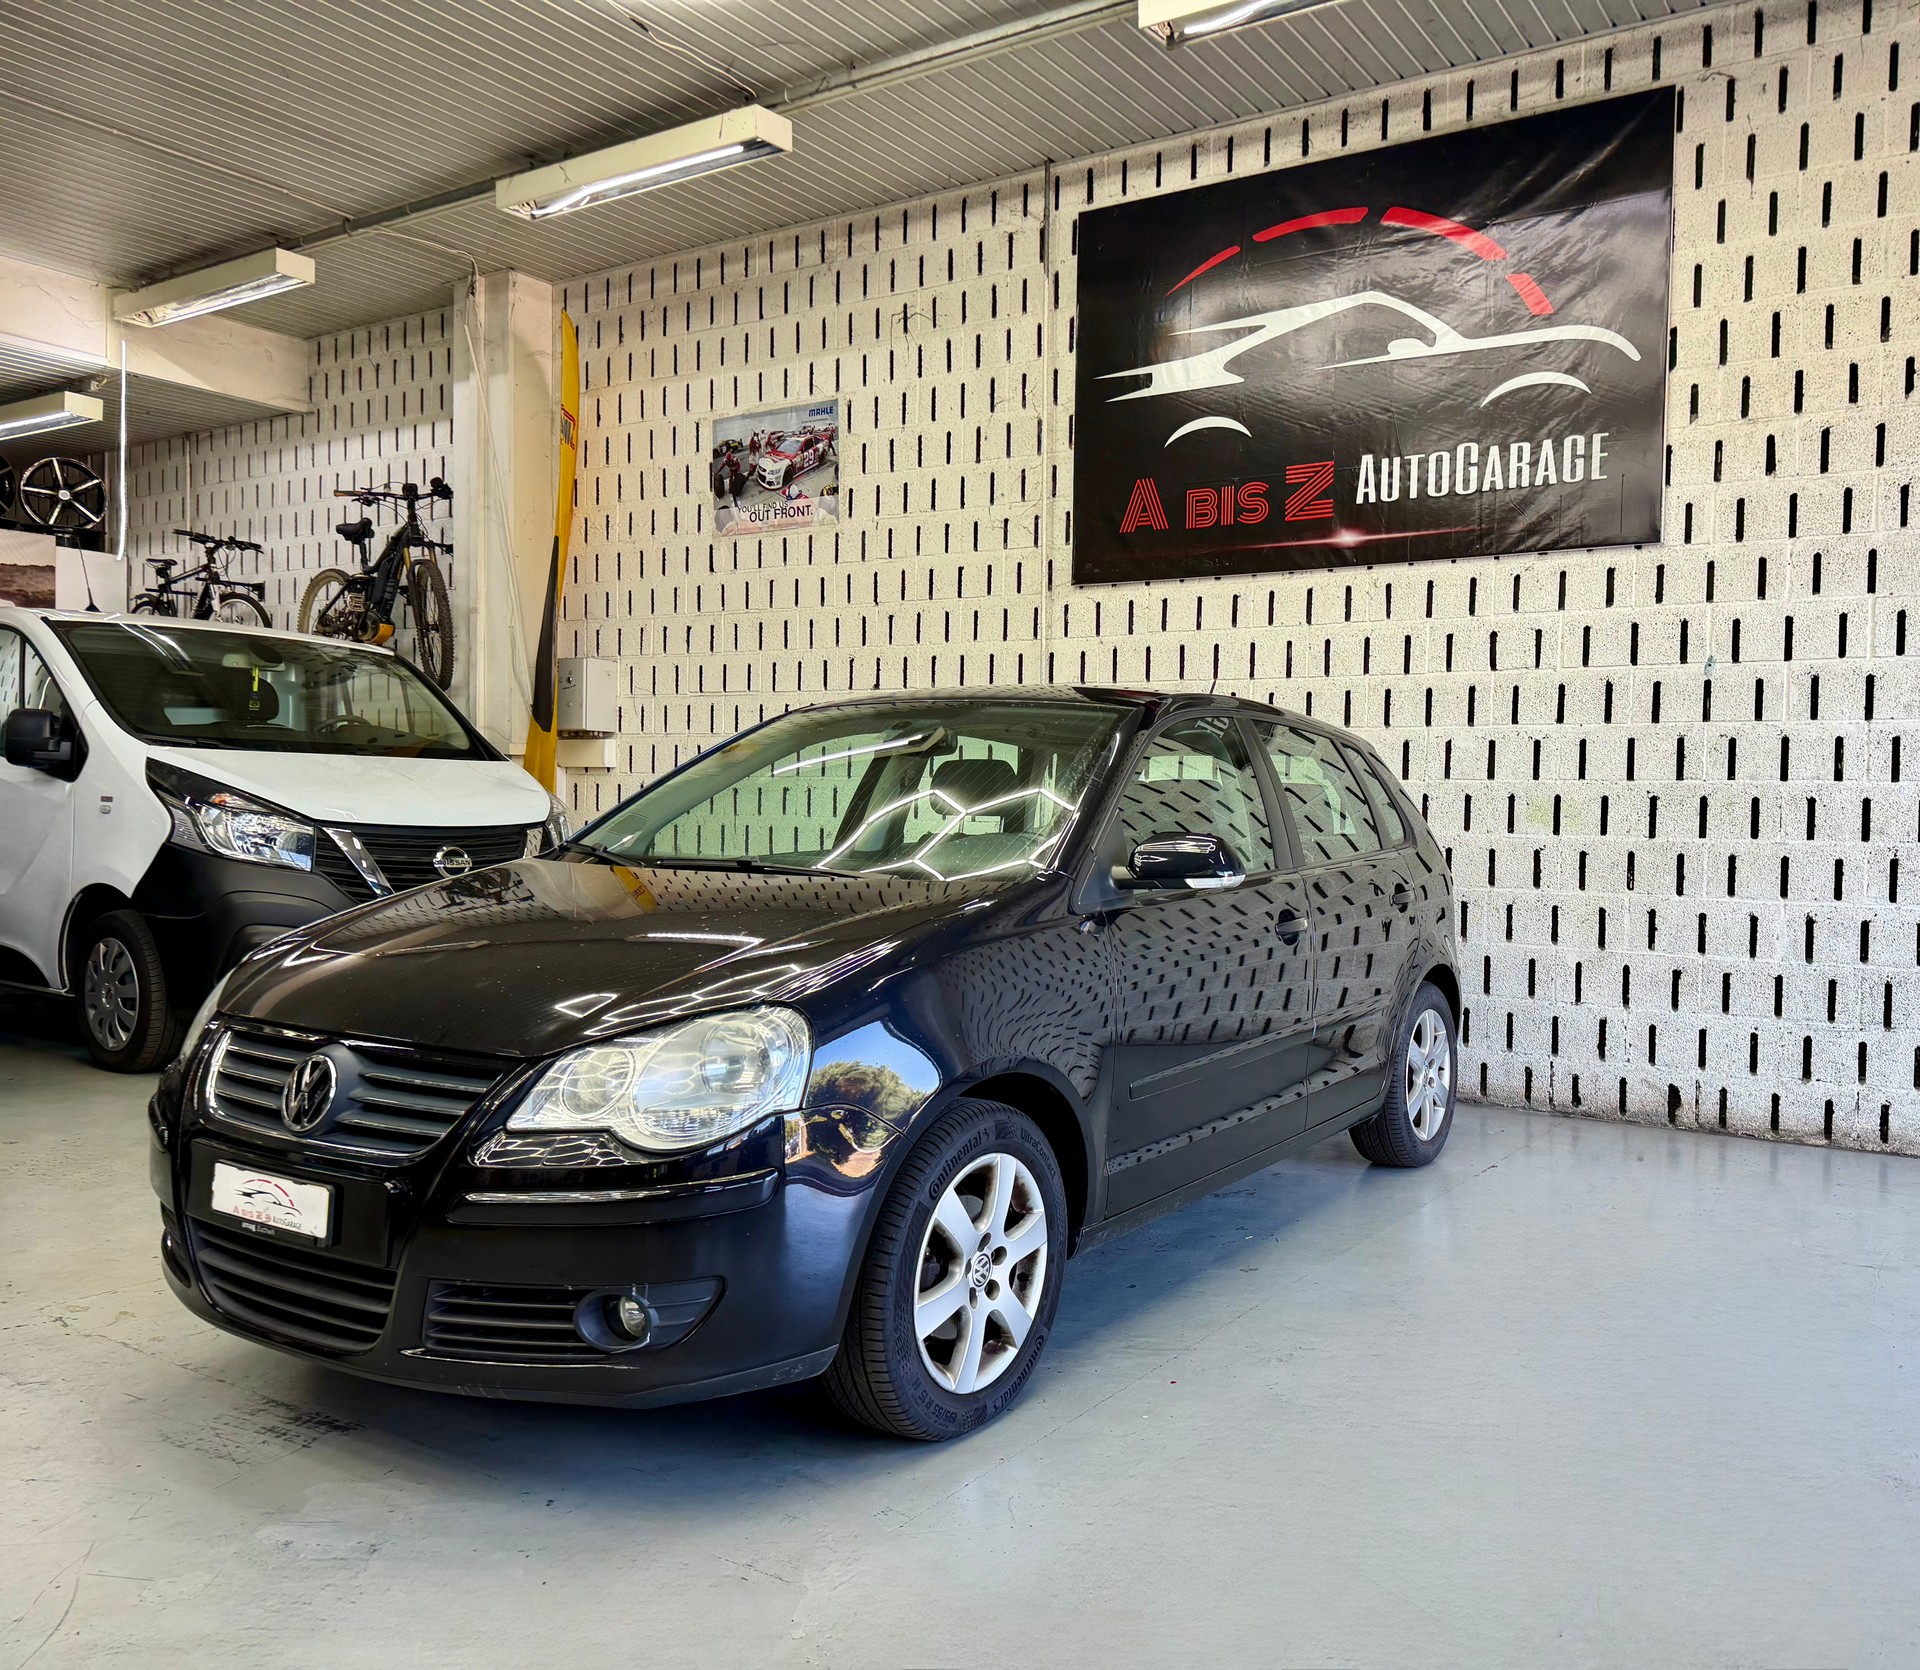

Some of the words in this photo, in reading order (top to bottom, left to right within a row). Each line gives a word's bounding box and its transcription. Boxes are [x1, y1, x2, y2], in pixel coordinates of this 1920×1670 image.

[808, 405, 834, 418] MAHLE
[803, 449, 815, 468] 29
[1355, 432, 1610, 506] AUTOGARAGE
[749, 509, 771, 523] OUT
[774, 504, 814, 519] FRONT.
[1118, 478, 1170, 534] A
[1185, 481, 1271, 530] BIS
[1284, 460, 1336, 522] Z
[929, 1130, 982, 1201] Continental
[1020, 1127, 1056, 1180] UltraContact
[232, 1205, 240, 1215] A
[1000, 1334, 1045, 1408] Continental
